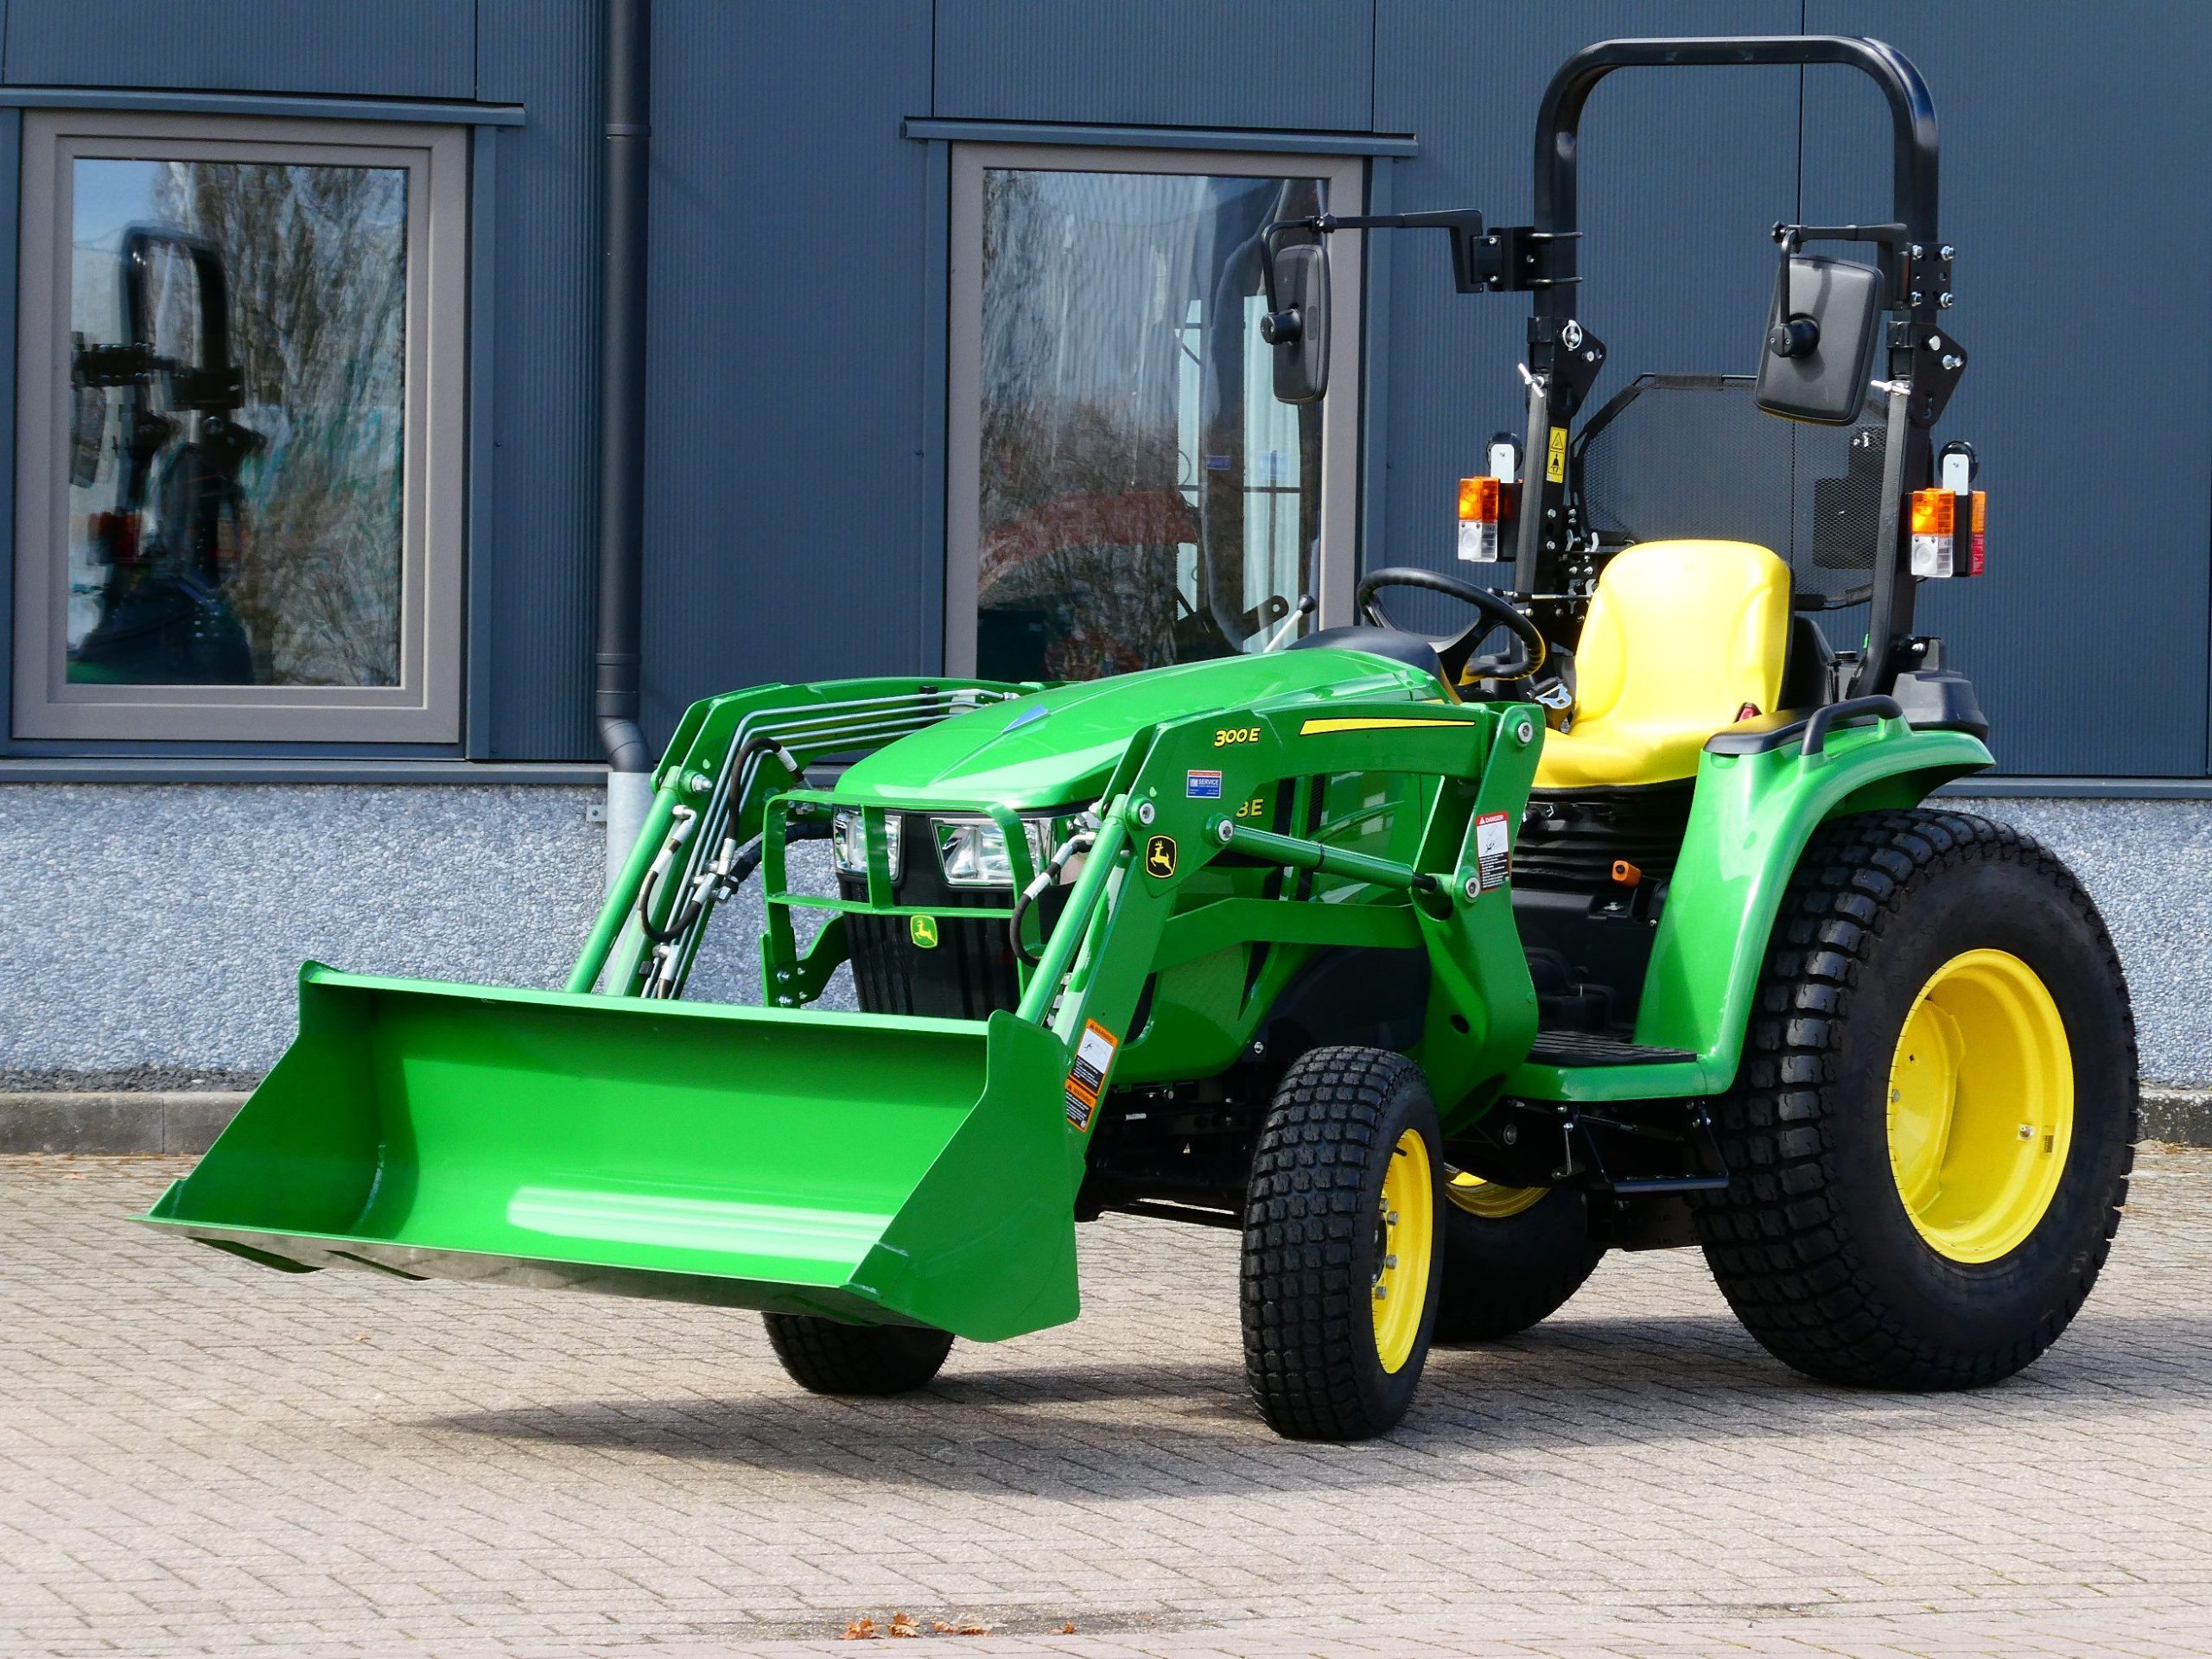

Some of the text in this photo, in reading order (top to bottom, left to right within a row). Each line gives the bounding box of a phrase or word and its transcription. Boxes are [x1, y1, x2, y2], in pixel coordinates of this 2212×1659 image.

[1214, 728, 1261, 747] 300E
[1485, 815, 1503, 823] DANGER
[1095, 1027, 1114, 1044] WARNING
[1073, 1087, 1092, 1104] WARNING
